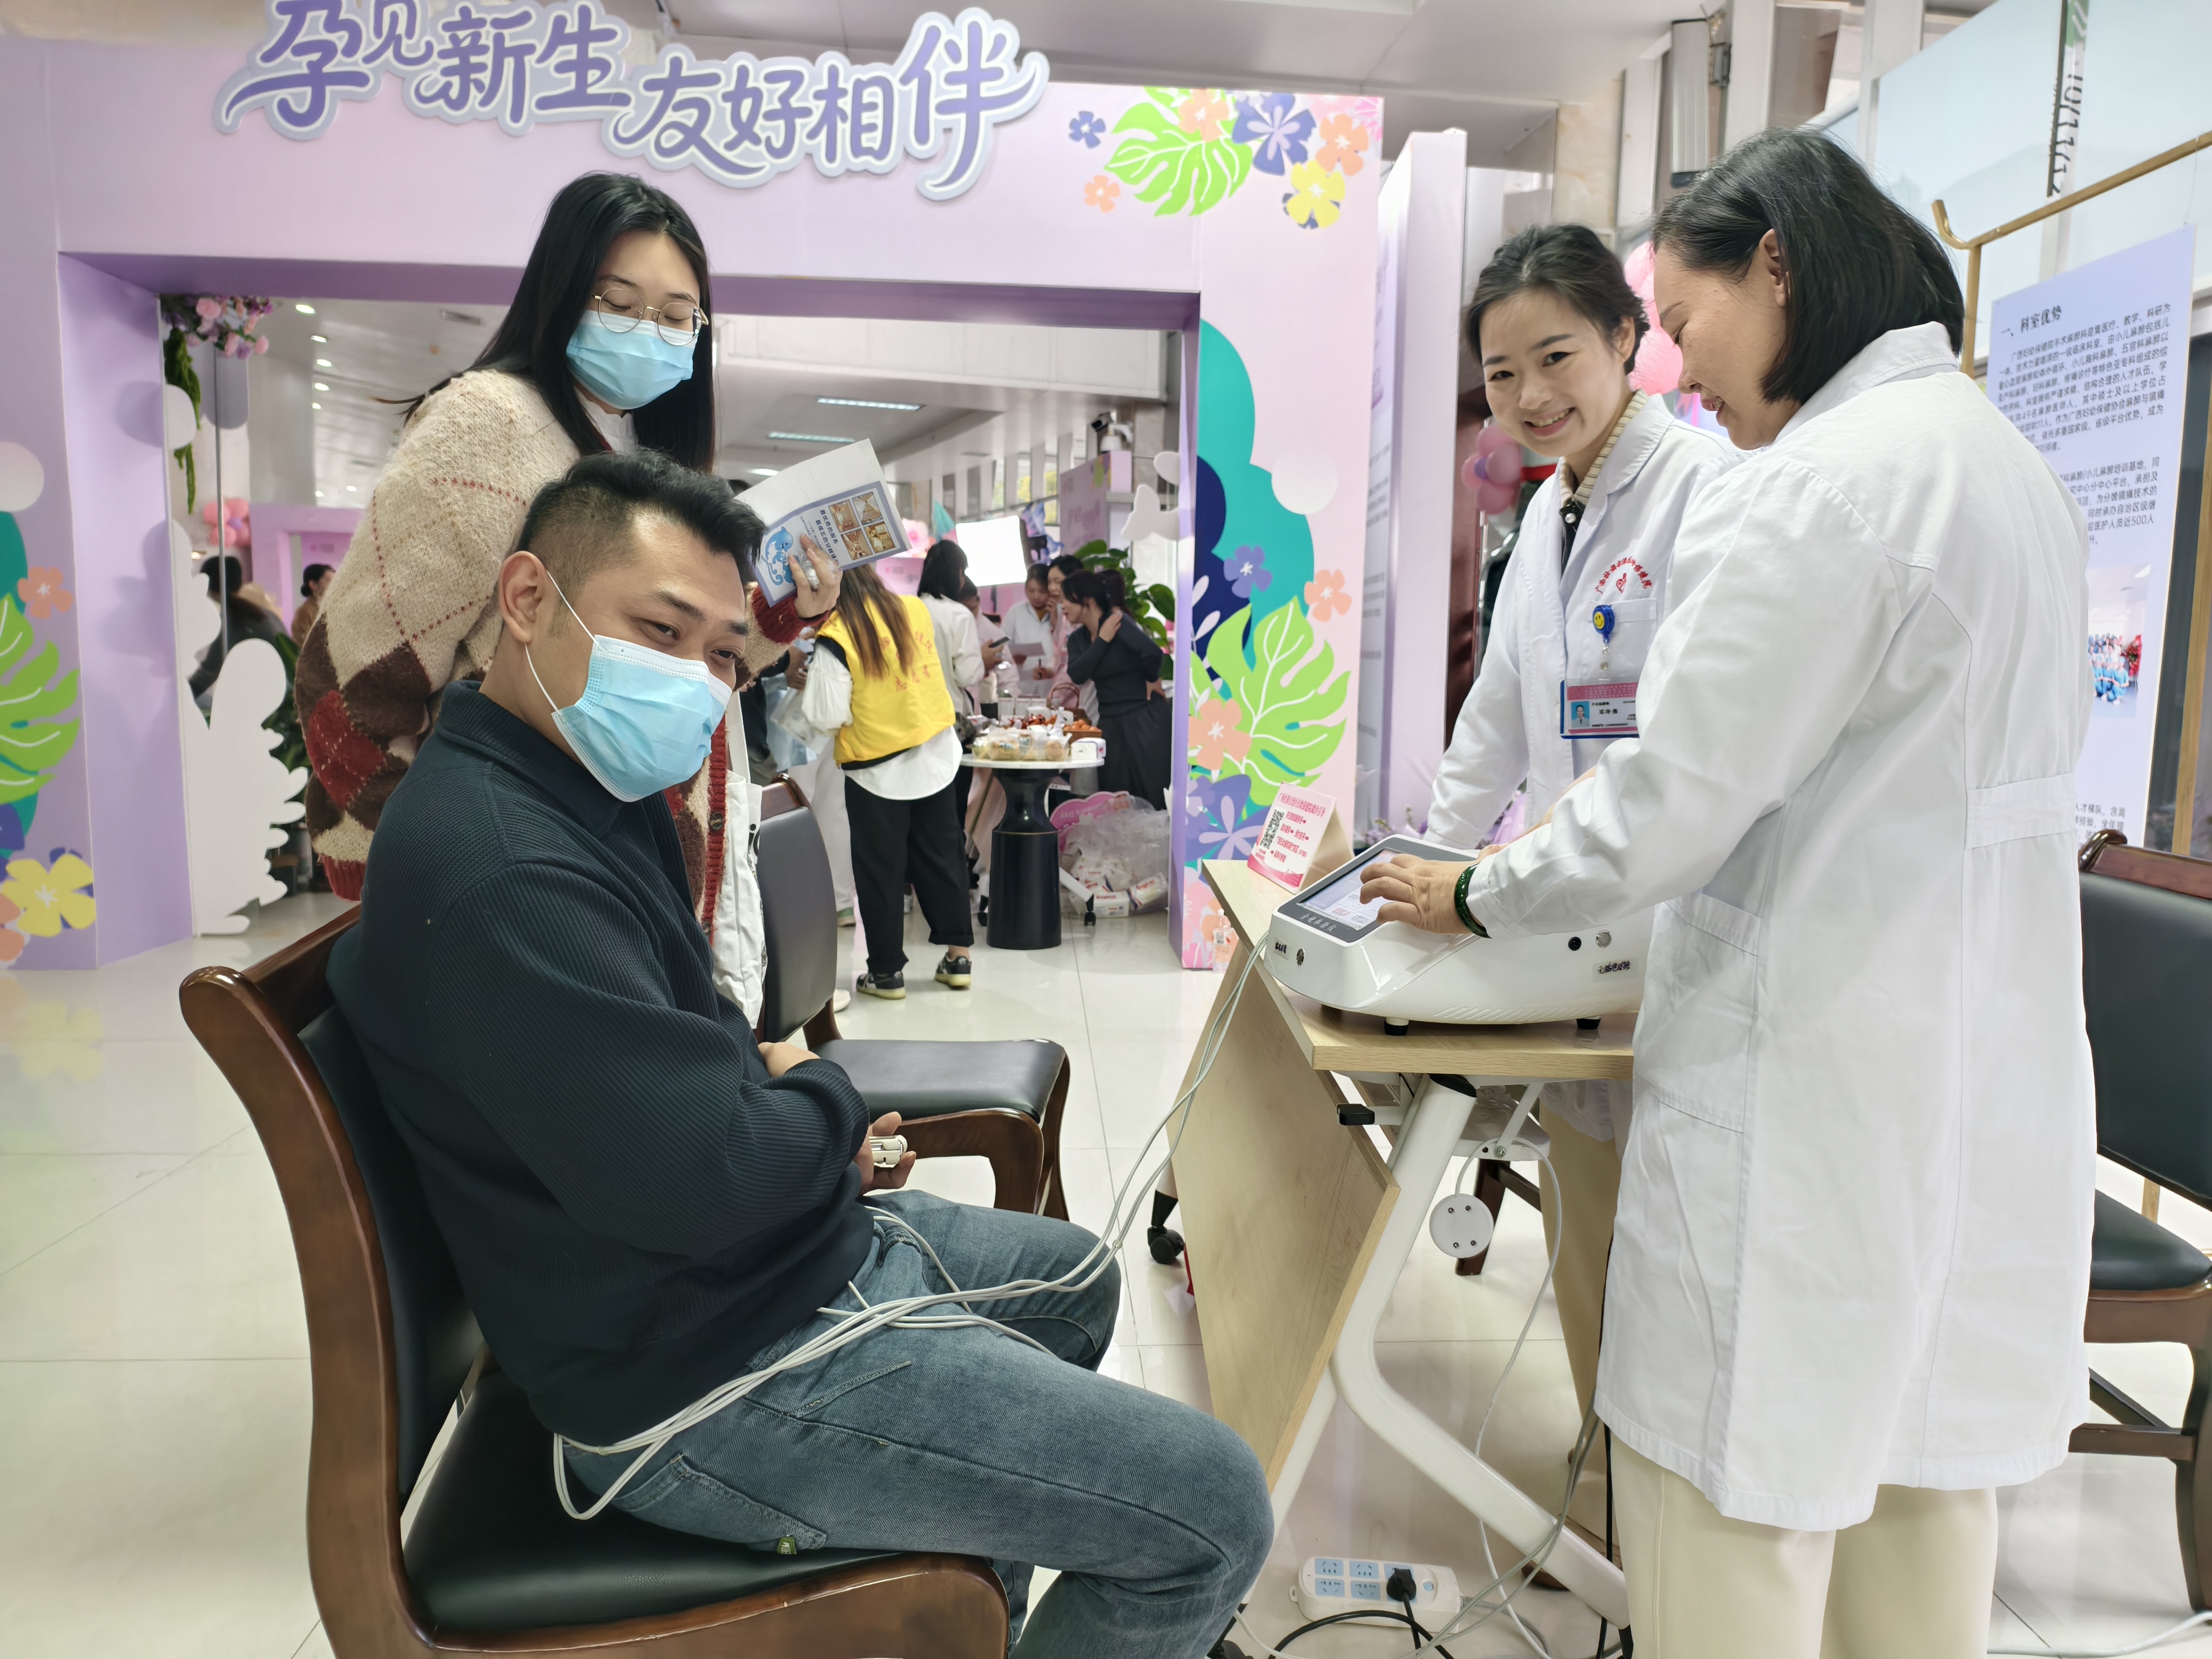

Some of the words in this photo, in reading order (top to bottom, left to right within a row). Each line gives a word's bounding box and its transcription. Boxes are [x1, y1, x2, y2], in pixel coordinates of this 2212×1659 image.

[225, 0, 631, 126] 孕见新生
[621, 21, 1037, 186] 友好相伴
